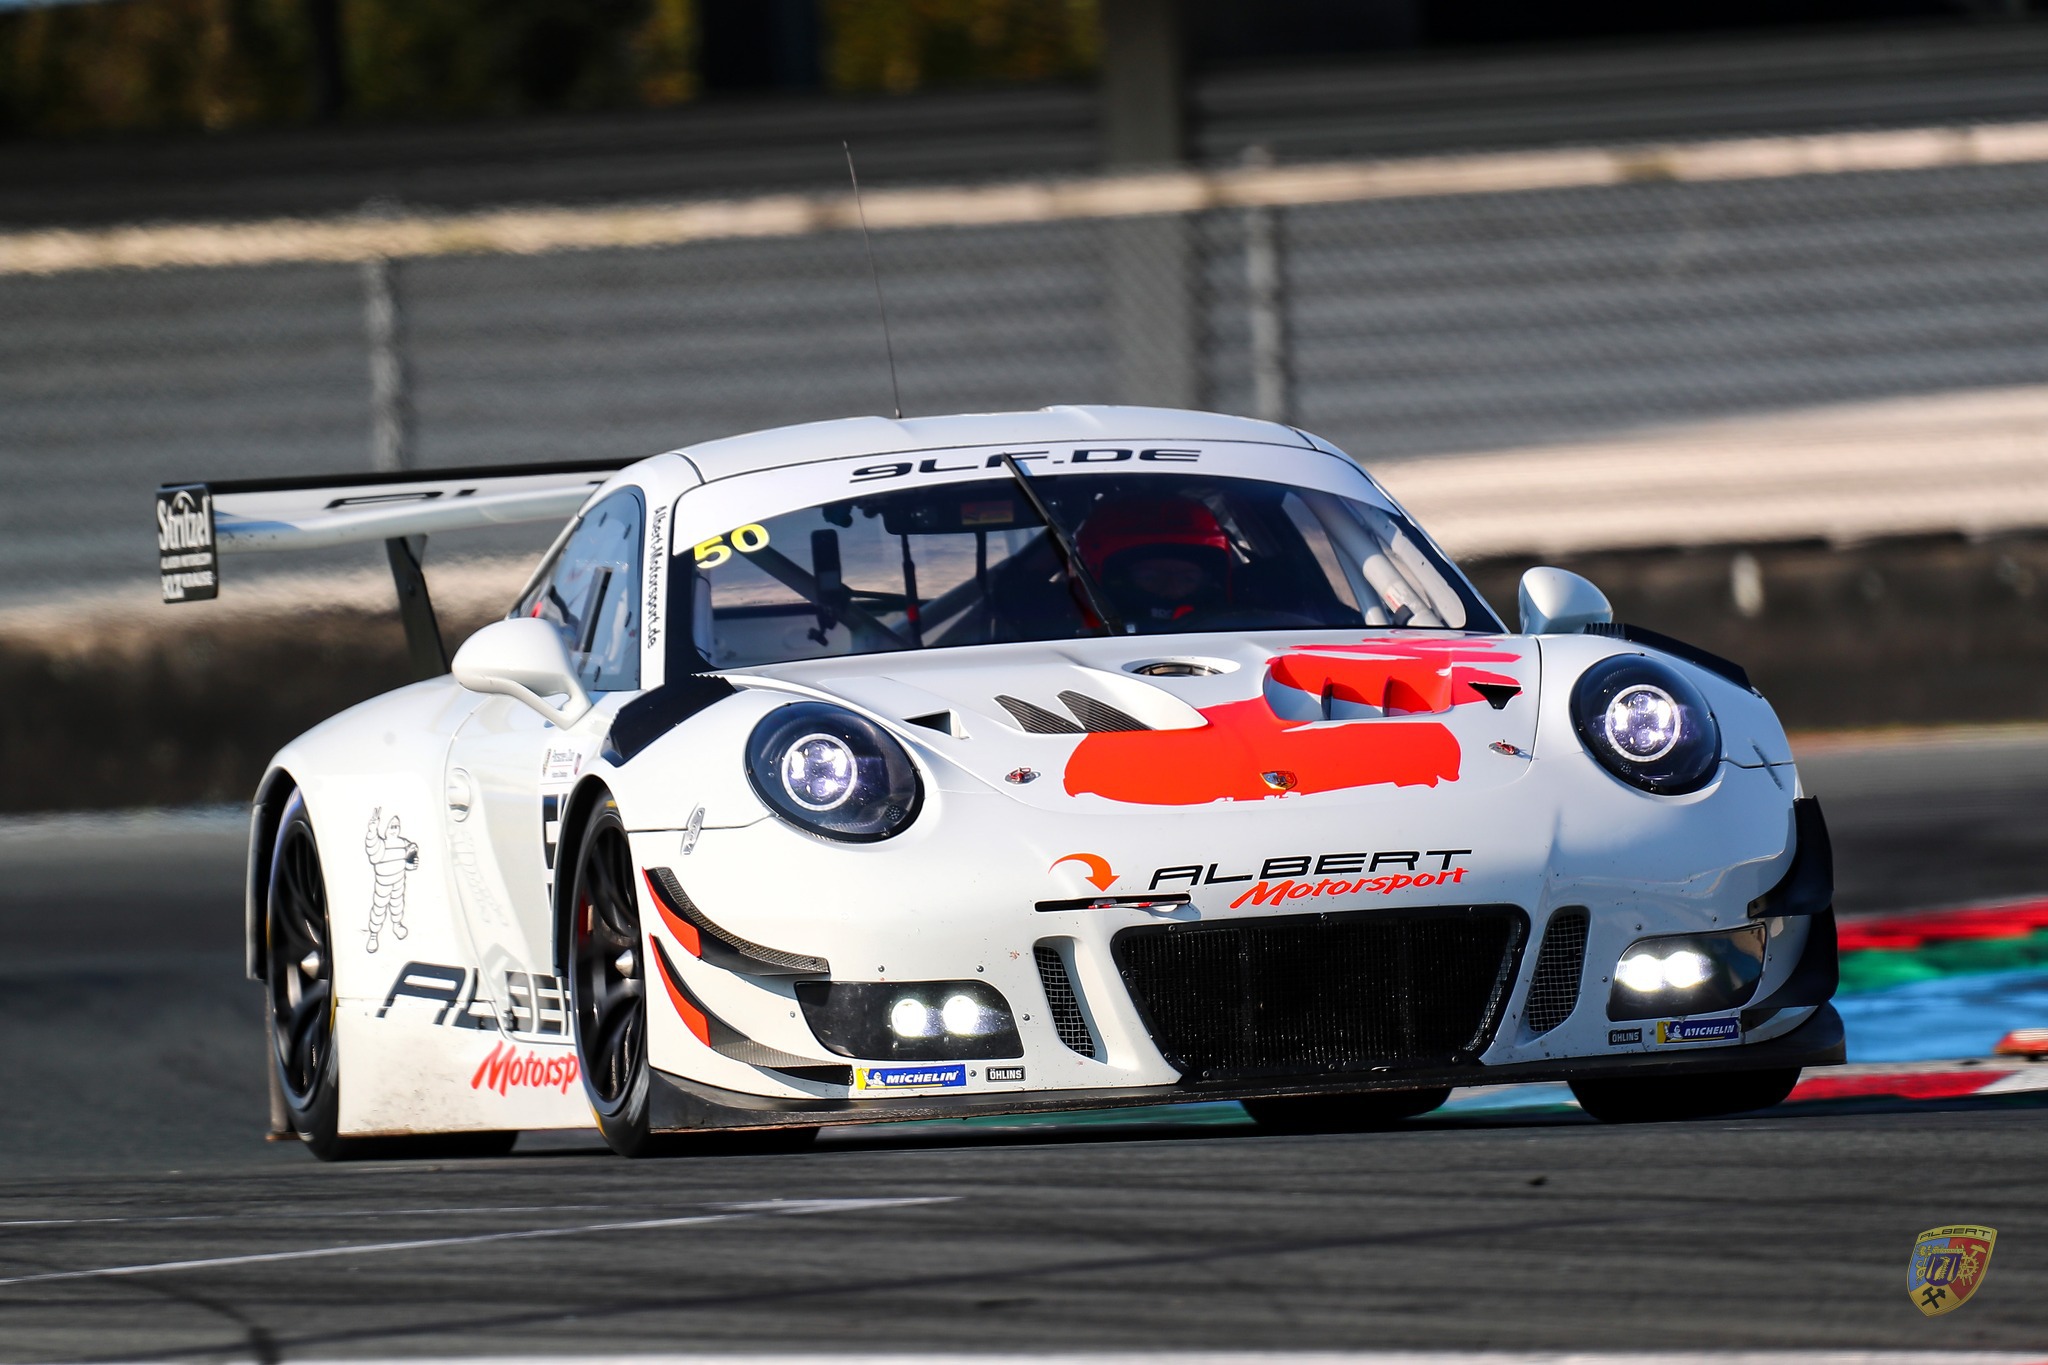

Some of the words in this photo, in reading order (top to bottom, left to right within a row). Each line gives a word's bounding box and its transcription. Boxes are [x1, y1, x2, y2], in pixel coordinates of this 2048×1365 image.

[694, 523, 770, 569] 50
[1148, 849, 1472, 891] ALBERT
[1229, 867, 1468, 910] Motorsport
[1612, 1031, 1640, 1043] ÖHLINS
[1684, 1024, 1735, 1037] MICHELIN
[470, 1040, 583, 1098] Motorsp
[886, 1070, 960, 1084] MICHELIN
[989, 1068, 1023, 1080] ÖHLINS
